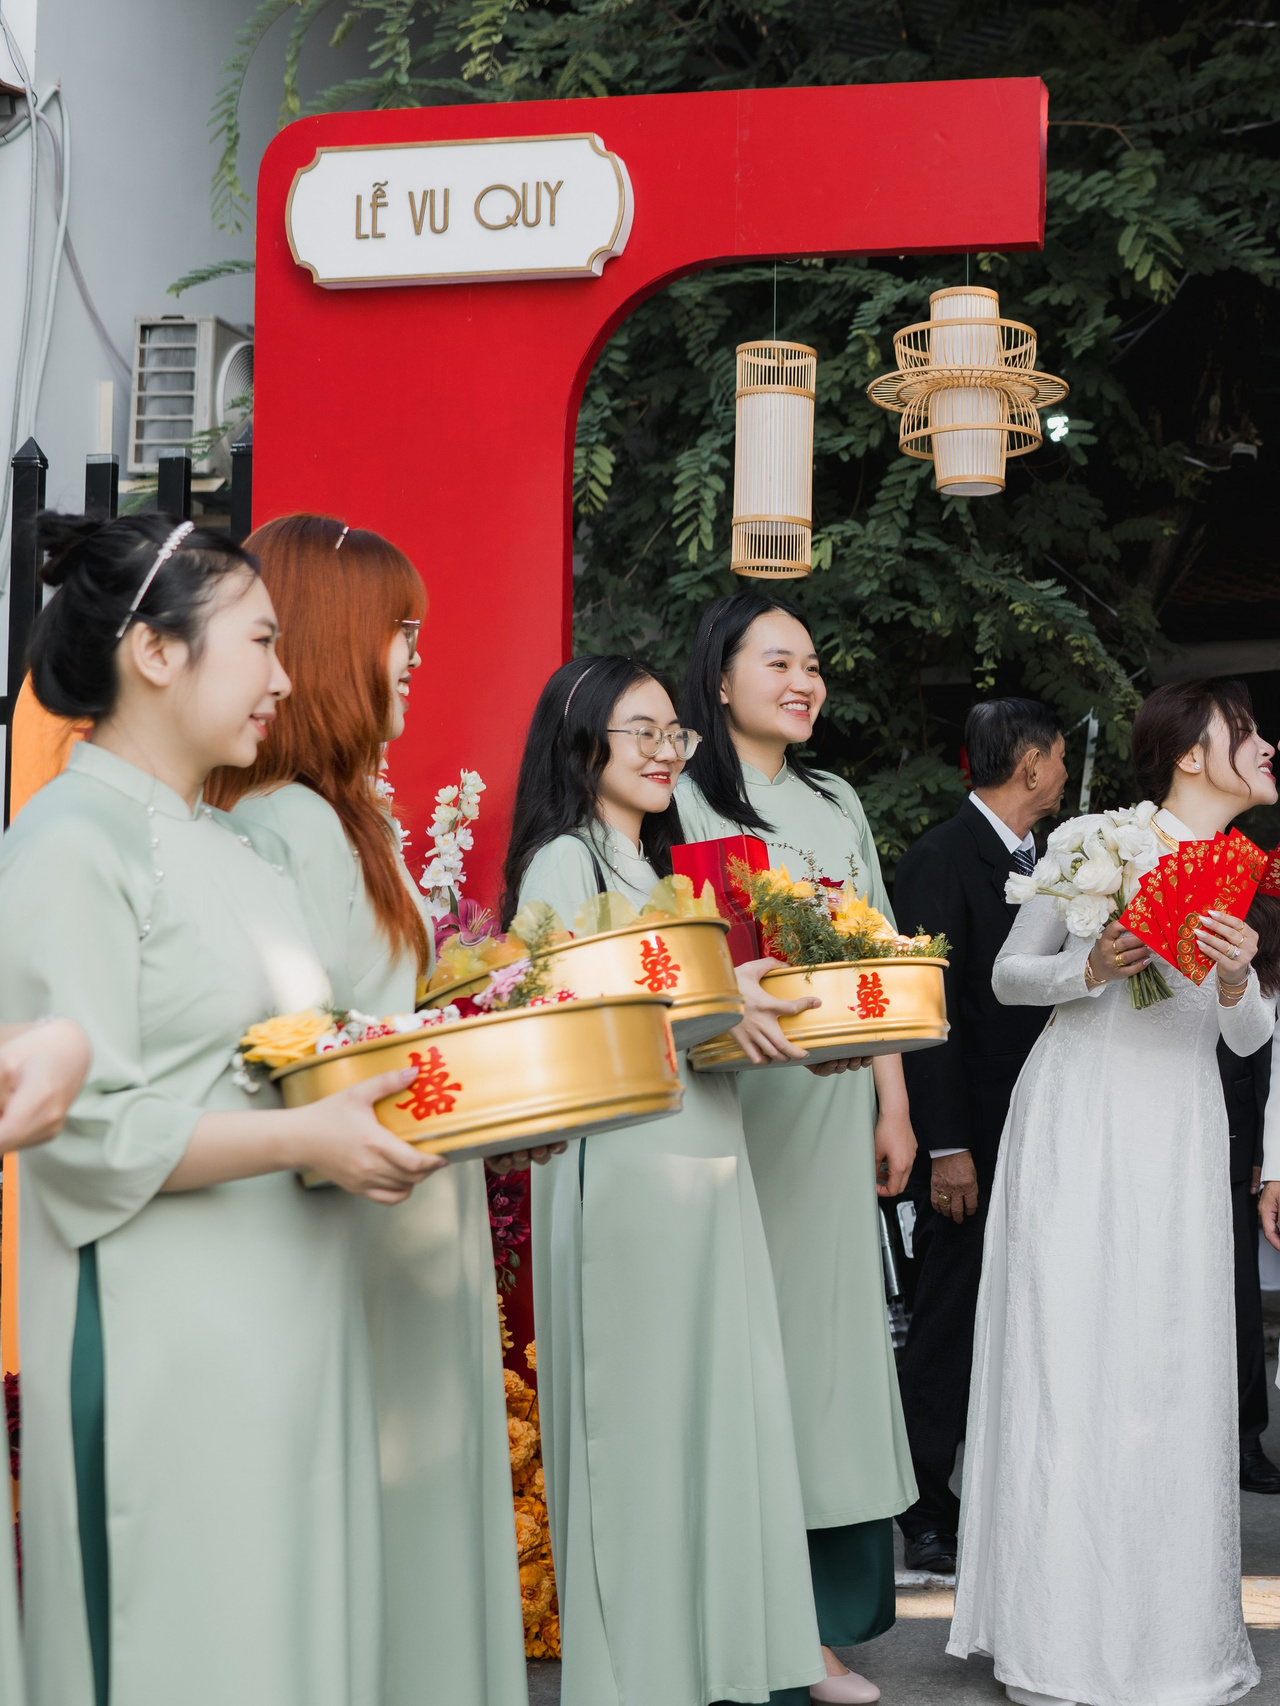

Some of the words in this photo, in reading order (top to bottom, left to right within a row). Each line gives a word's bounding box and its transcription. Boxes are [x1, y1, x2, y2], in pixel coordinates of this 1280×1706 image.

[354, 180, 388, 239] LỄ
[408, 187, 450, 235] VU
[473, 180, 564, 231] QUY
